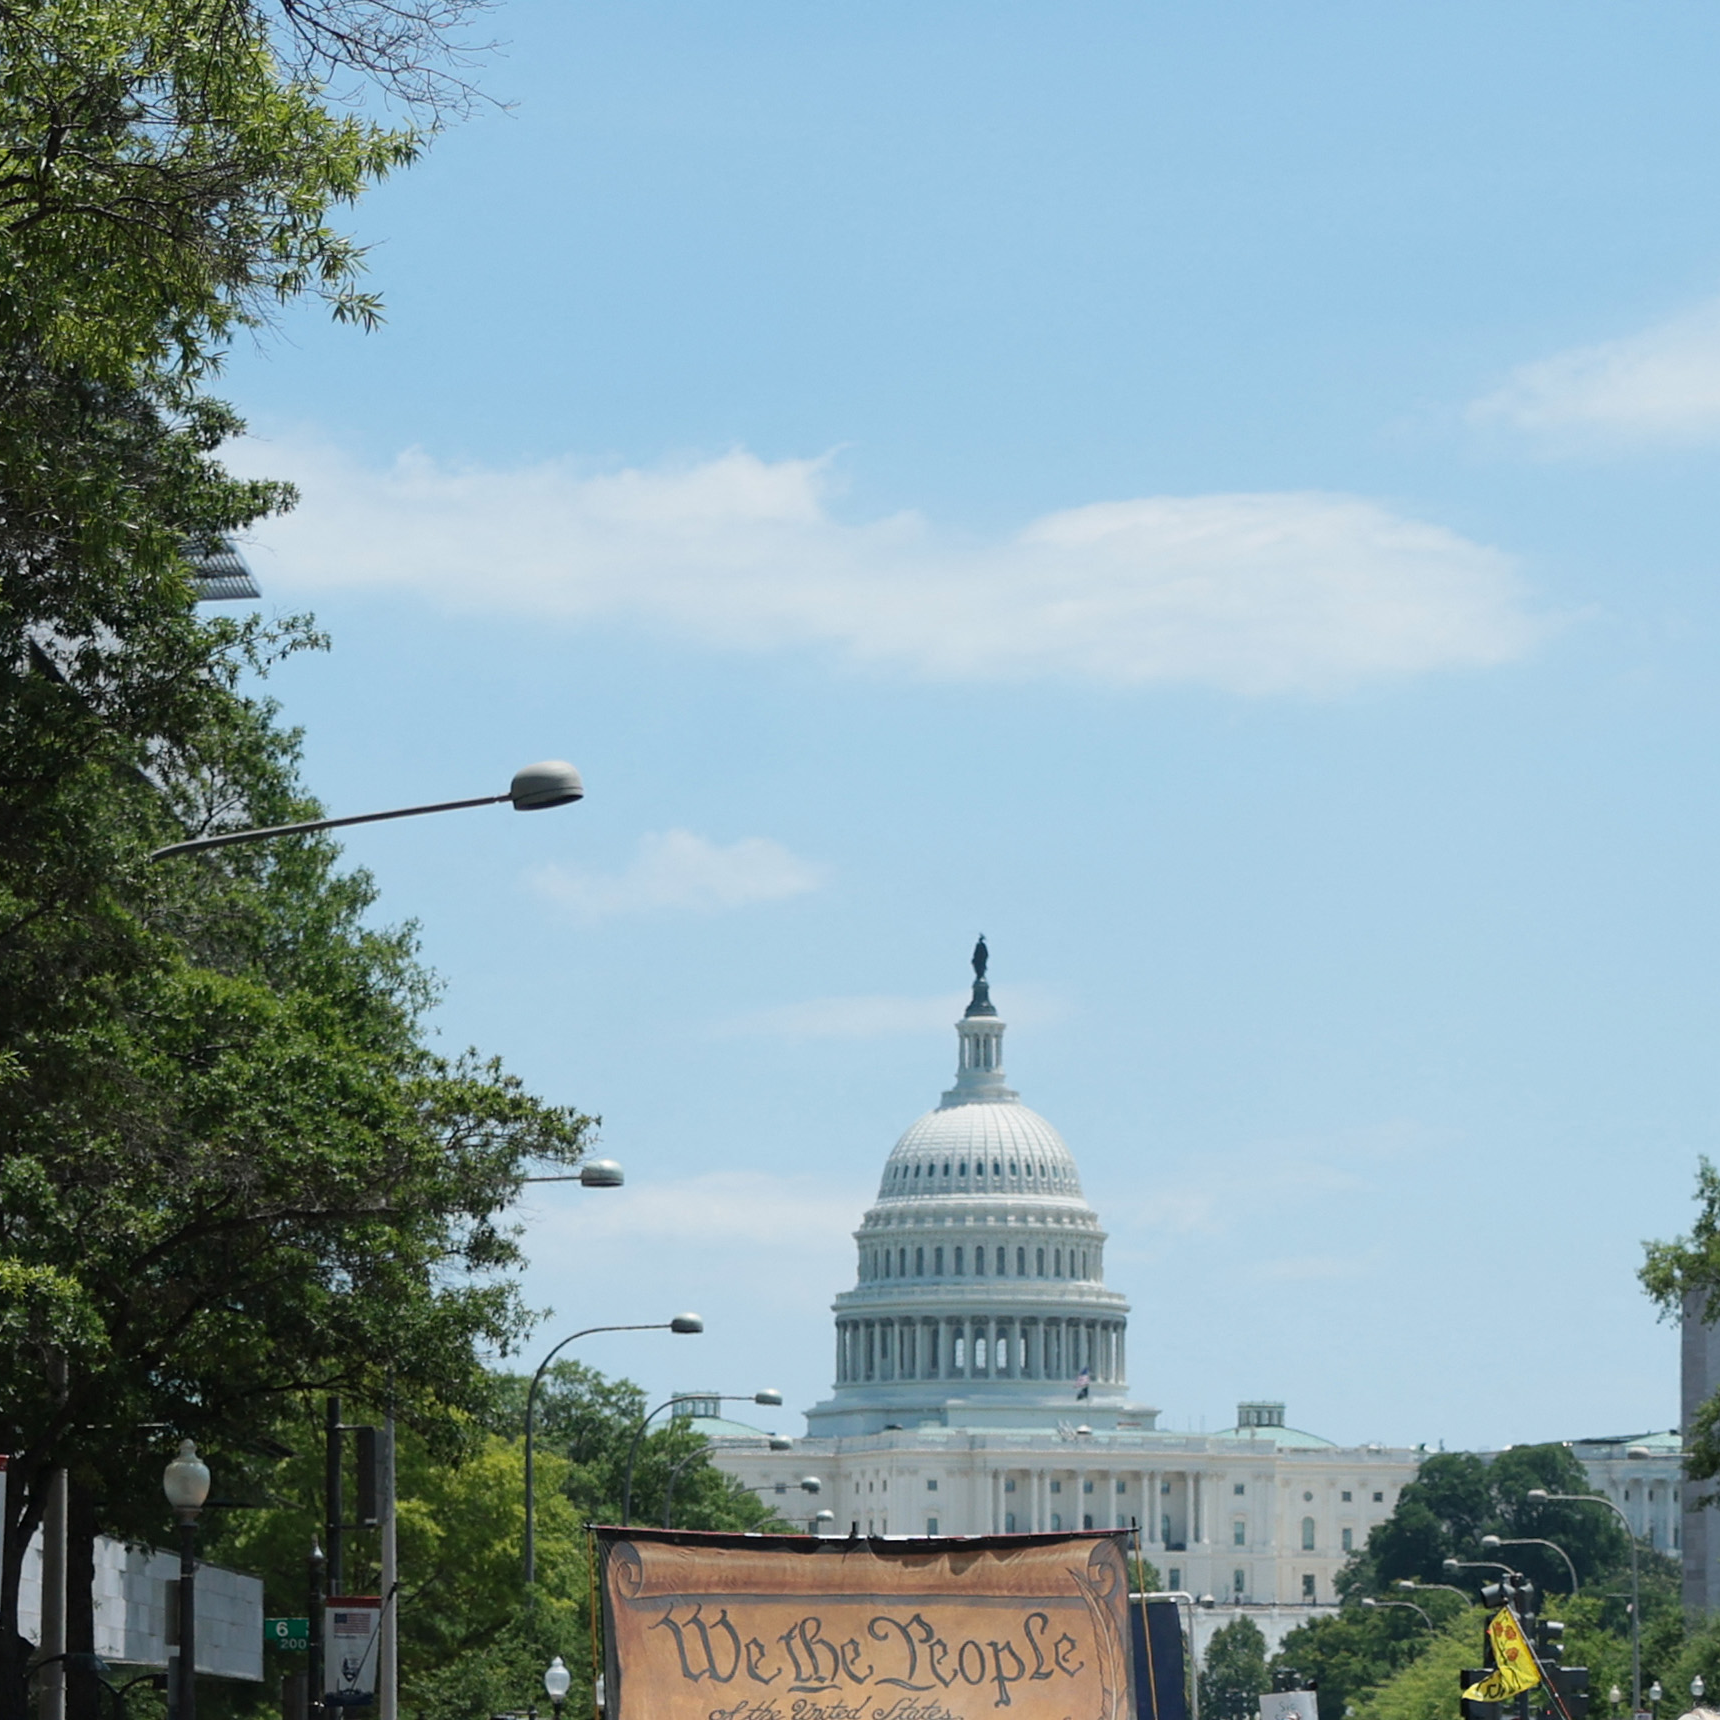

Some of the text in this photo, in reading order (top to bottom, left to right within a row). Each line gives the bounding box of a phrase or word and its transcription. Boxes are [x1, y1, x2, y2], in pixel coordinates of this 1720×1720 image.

[275, 1621, 289, 1637] 6
[280, 1638, 307, 1649] 200
[648, 1602, 1085, 1709] We the People
